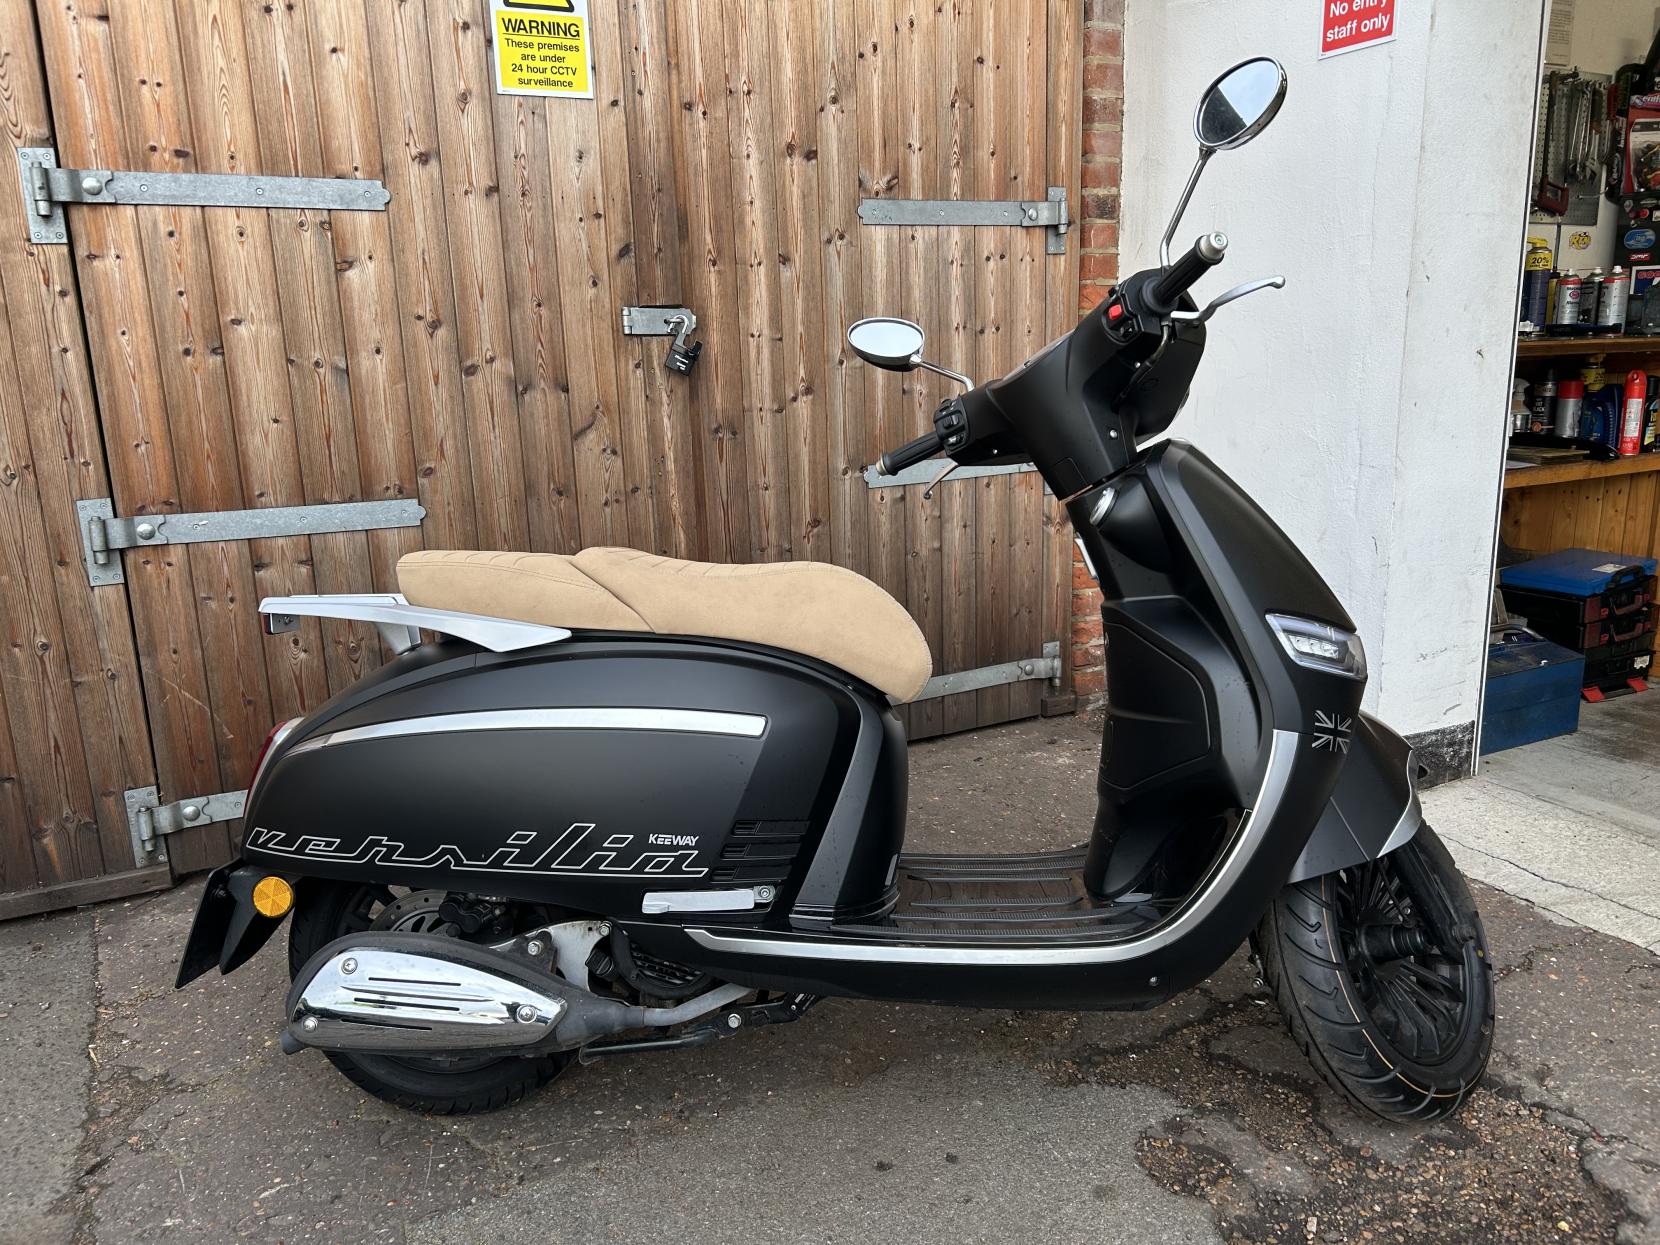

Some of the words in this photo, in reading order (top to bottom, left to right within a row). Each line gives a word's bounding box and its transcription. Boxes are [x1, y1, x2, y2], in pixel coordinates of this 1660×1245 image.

[1330, 2, 1348, 18] No
[502, 17, 580, 38] WARNING
[1326, 19, 1358, 42] staff
[1361, 12, 1390, 33] only
[504, 38, 534, 49] These
[537, 40, 580, 53] premises
[521, 53, 536, 62] are
[539, 53, 566, 63] under
[511, 63, 523, 73] 24
[526, 65, 547, 75] hour
[550, 65, 577, 76] CCTV
[518, 77, 574, 88] surveillance
[1531, 256, 1550, 265] 20%
[648, 833, 699, 846] KEEWAY
